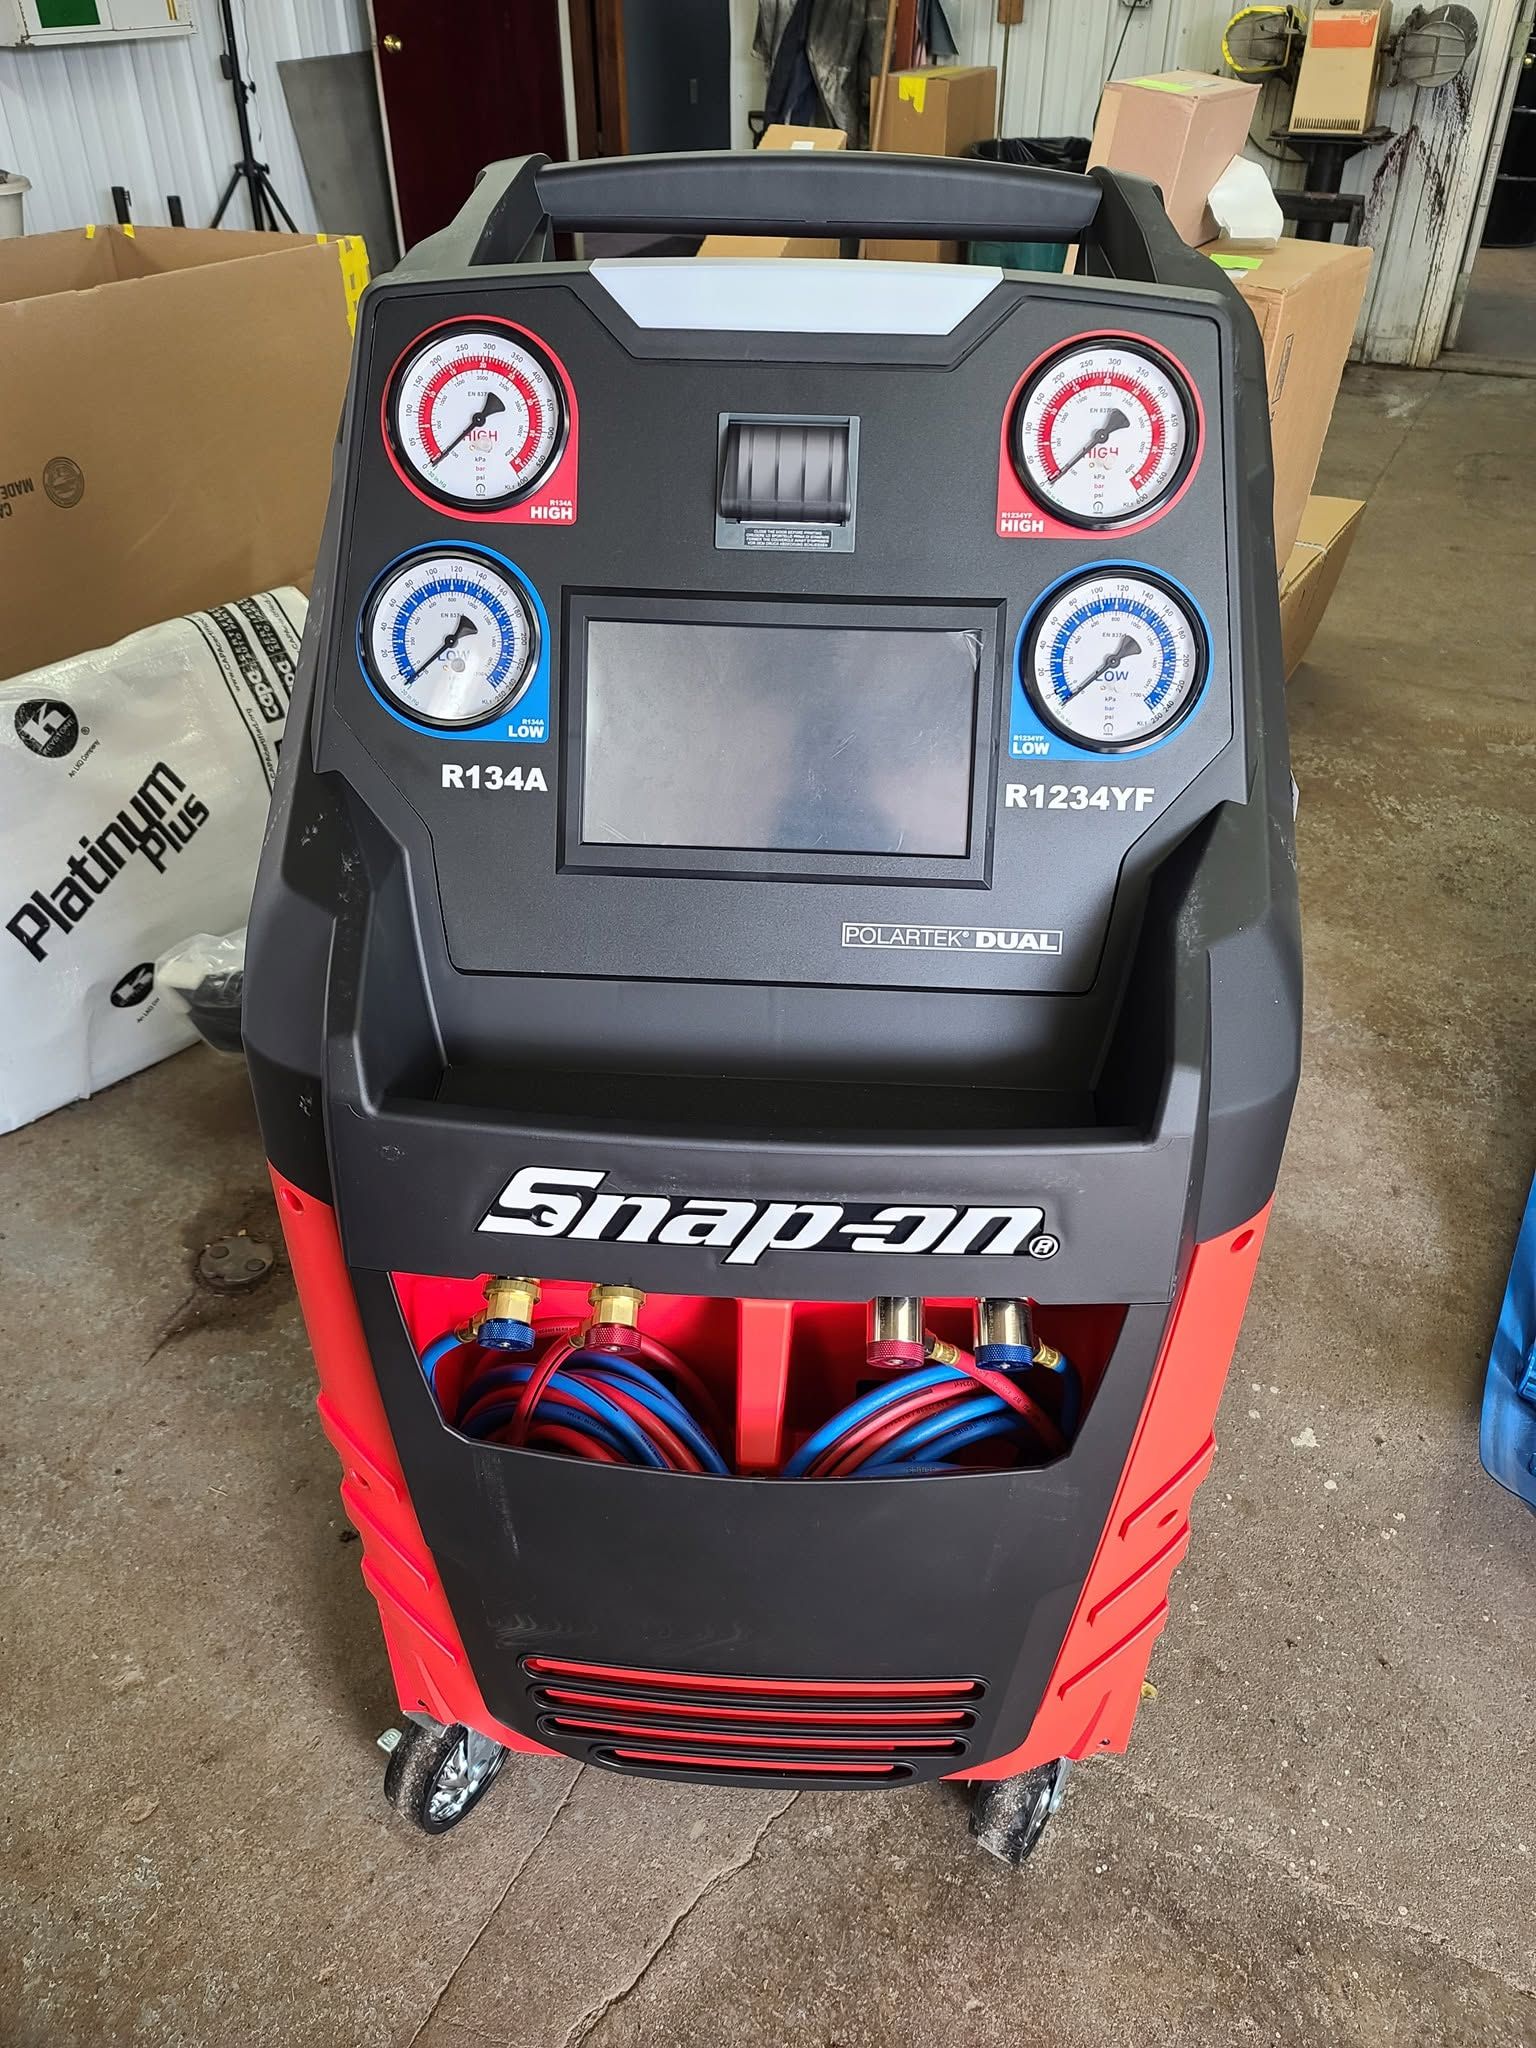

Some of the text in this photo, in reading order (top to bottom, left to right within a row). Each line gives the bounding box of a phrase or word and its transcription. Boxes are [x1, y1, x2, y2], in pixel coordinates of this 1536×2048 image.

[455, 344, 468, 352] 250
[430, 355, 442, 366] 200
[510, 352, 523, 363] 350
[1080, 360, 1093, 368] 250
[532, 372, 543, 383] 400
[1136, 367, 1149, 377] 350
[413, 376, 424, 388] 150
[1053, 372, 1065, 384] 200
[1158, 386, 1168, 398] 400
[1034, 393, 1044, 405] 150
[409, 438, 416, 446] 50
[536, 455, 545, 467] 550
[1027, 456, 1034, 464] 50
[518, 476, 528, 487] 600
[1157, 472, 1167, 485] 550
[1136, 493, 1148, 504] 600
[530, 507, 573, 519] HIGH
[1000, 520, 1044, 532] HIGH
[425, 568, 437, 576] 100
[475, 571, 488, 580] 140
[404, 579, 414, 588] 80
[497, 585, 508, 596] 160
[1142, 590, 1154, 600] 140
[389, 598, 397, 607] 60
[1069, 598, 1077, 606] 80
[513, 606, 521, 618] 180
[1163, 605, 1174, 616] 160
[1051, 616, 1058, 625] 60
[381, 622, 387, 631] 40
[1177, 627, 1186, 640] 180
[1040, 640, 1046, 650] 40
[381, 649, 388, 657] 20
[517, 658, 525, 671] 220
[1038, 668, 1044, 676] 20
[506, 679, 516, 689] 240
[1176, 680, 1185, 693] 220
[247, 669, 280, 719] capa
[495, 691, 506, 702] 250
[1163, 701, 1174, 712] 240
[1151, 713, 1163, 724] 250
[508, 726, 544, 738] LOW
[80, 738, 101, 762] Company
[1013, 742, 1050, 755] LOW
[441, 764, 548, 791] R134A
[1005, 784, 1155, 811] R1234YF
[139, 793, 210, 874] Plus
[5, 761, 187, 963] Platinum
[975, 931, 1058, 951] DUAL
